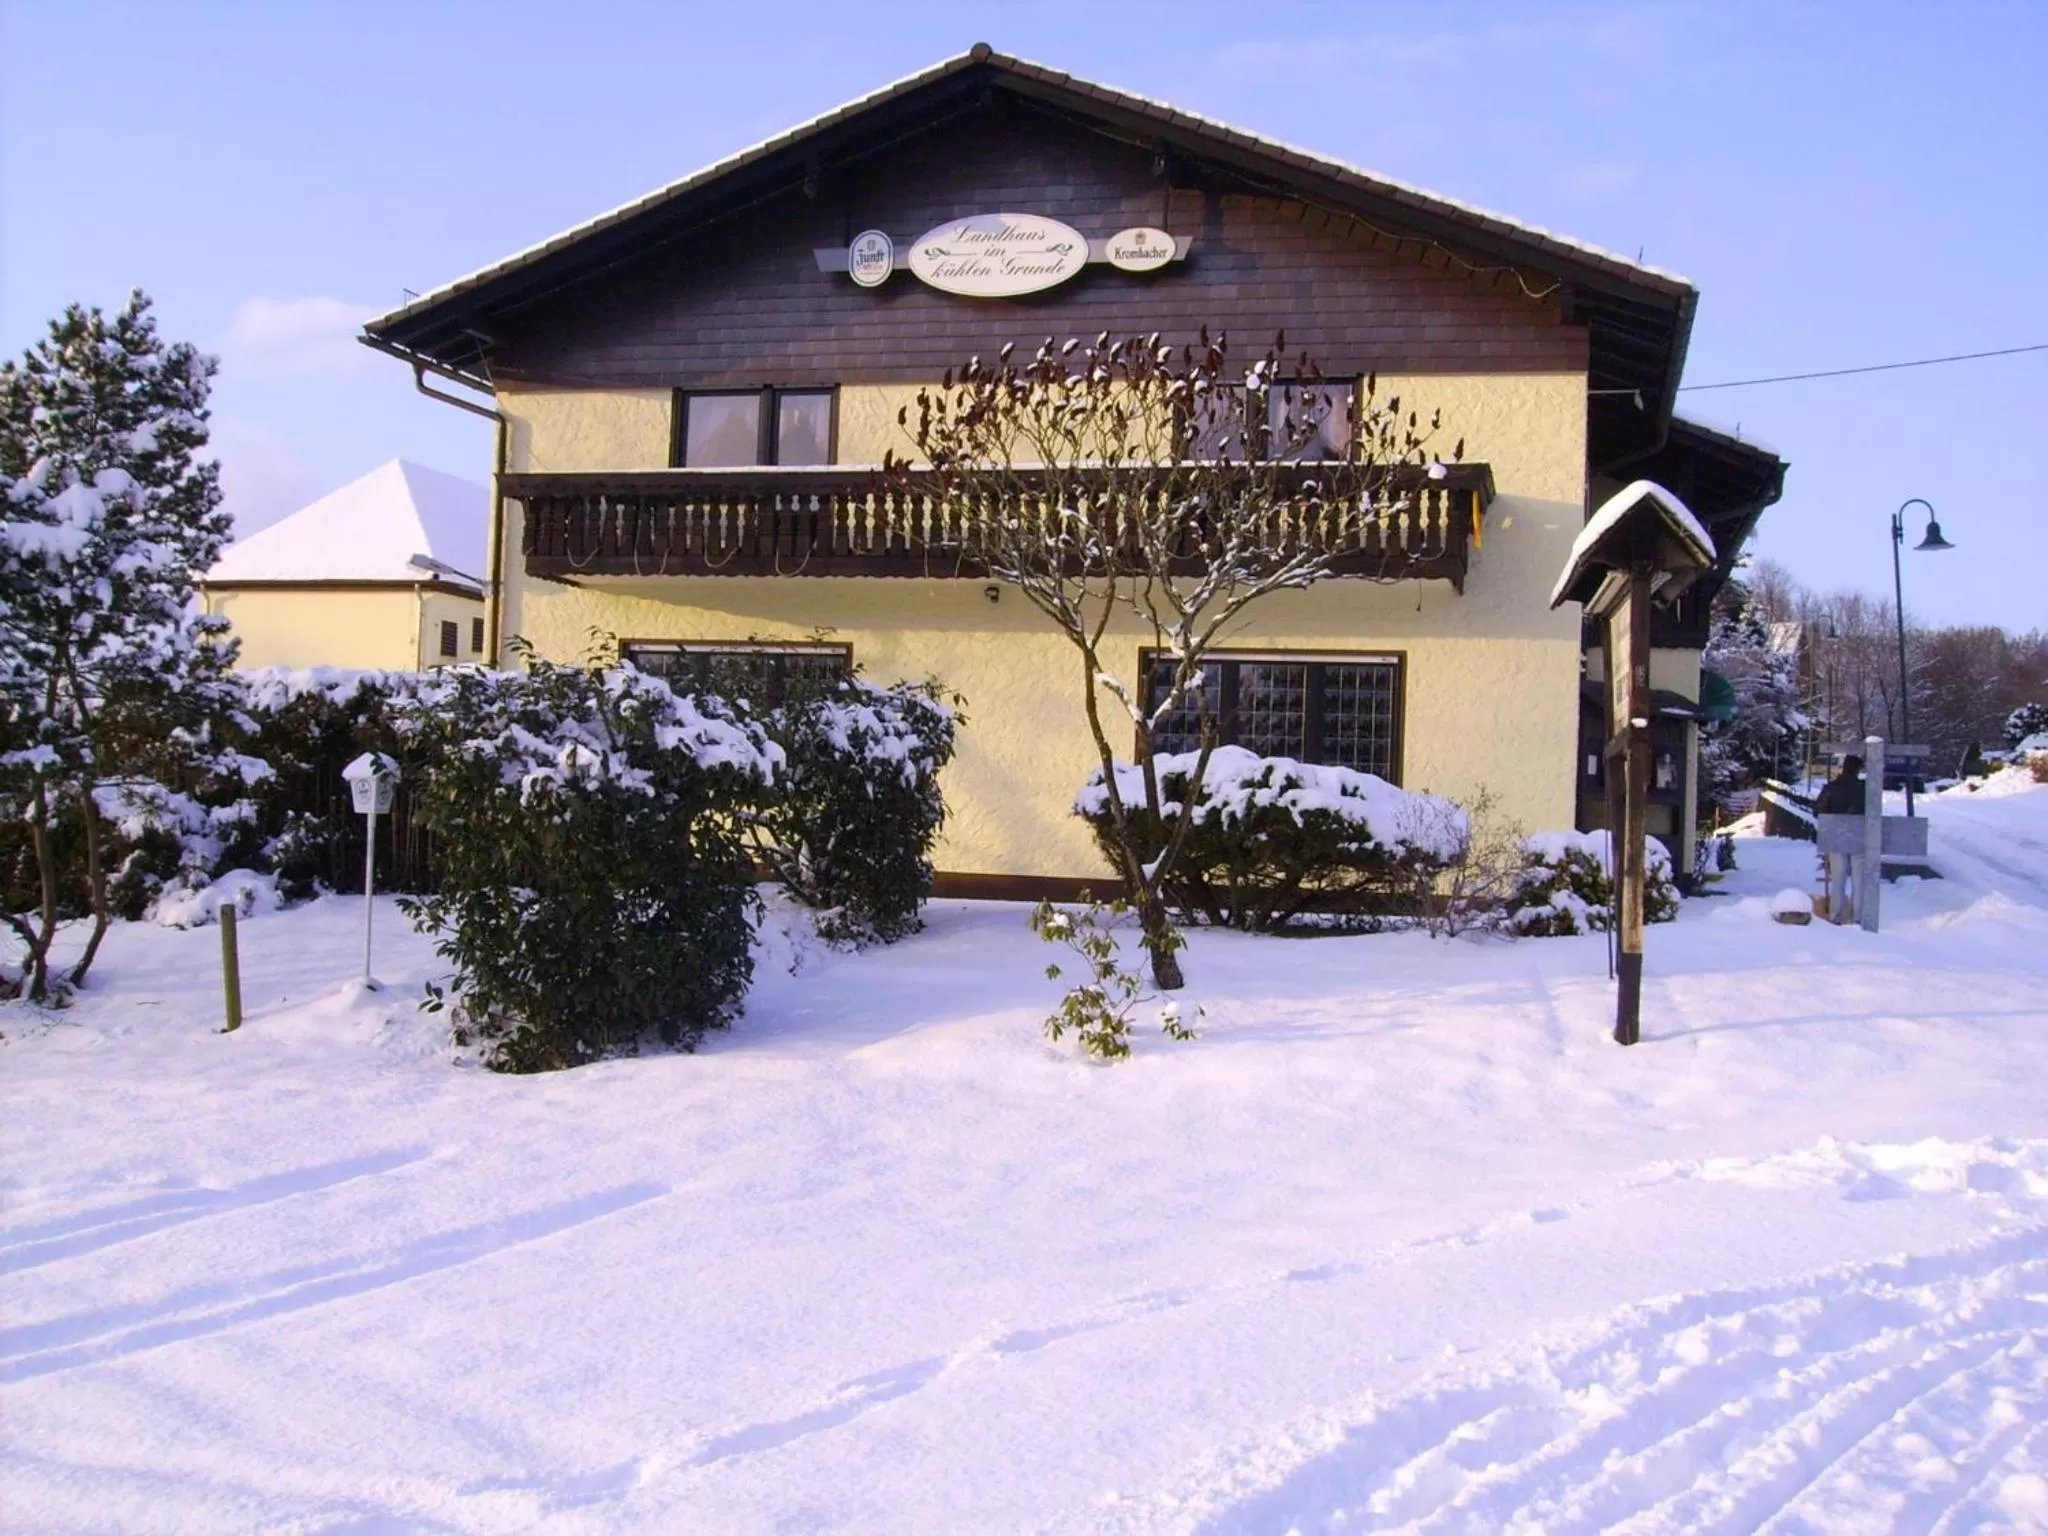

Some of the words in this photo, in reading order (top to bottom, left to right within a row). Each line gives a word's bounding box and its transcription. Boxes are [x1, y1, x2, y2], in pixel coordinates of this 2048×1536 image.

[952, 225, 1046, 243] Landhaus
[983, 243, 1006, 257] im
[1114, 246, 1168, 260] Krombacher
[931, 259, 991, 278] kühlen
[1000, 256, 1066, 276] Grunde
